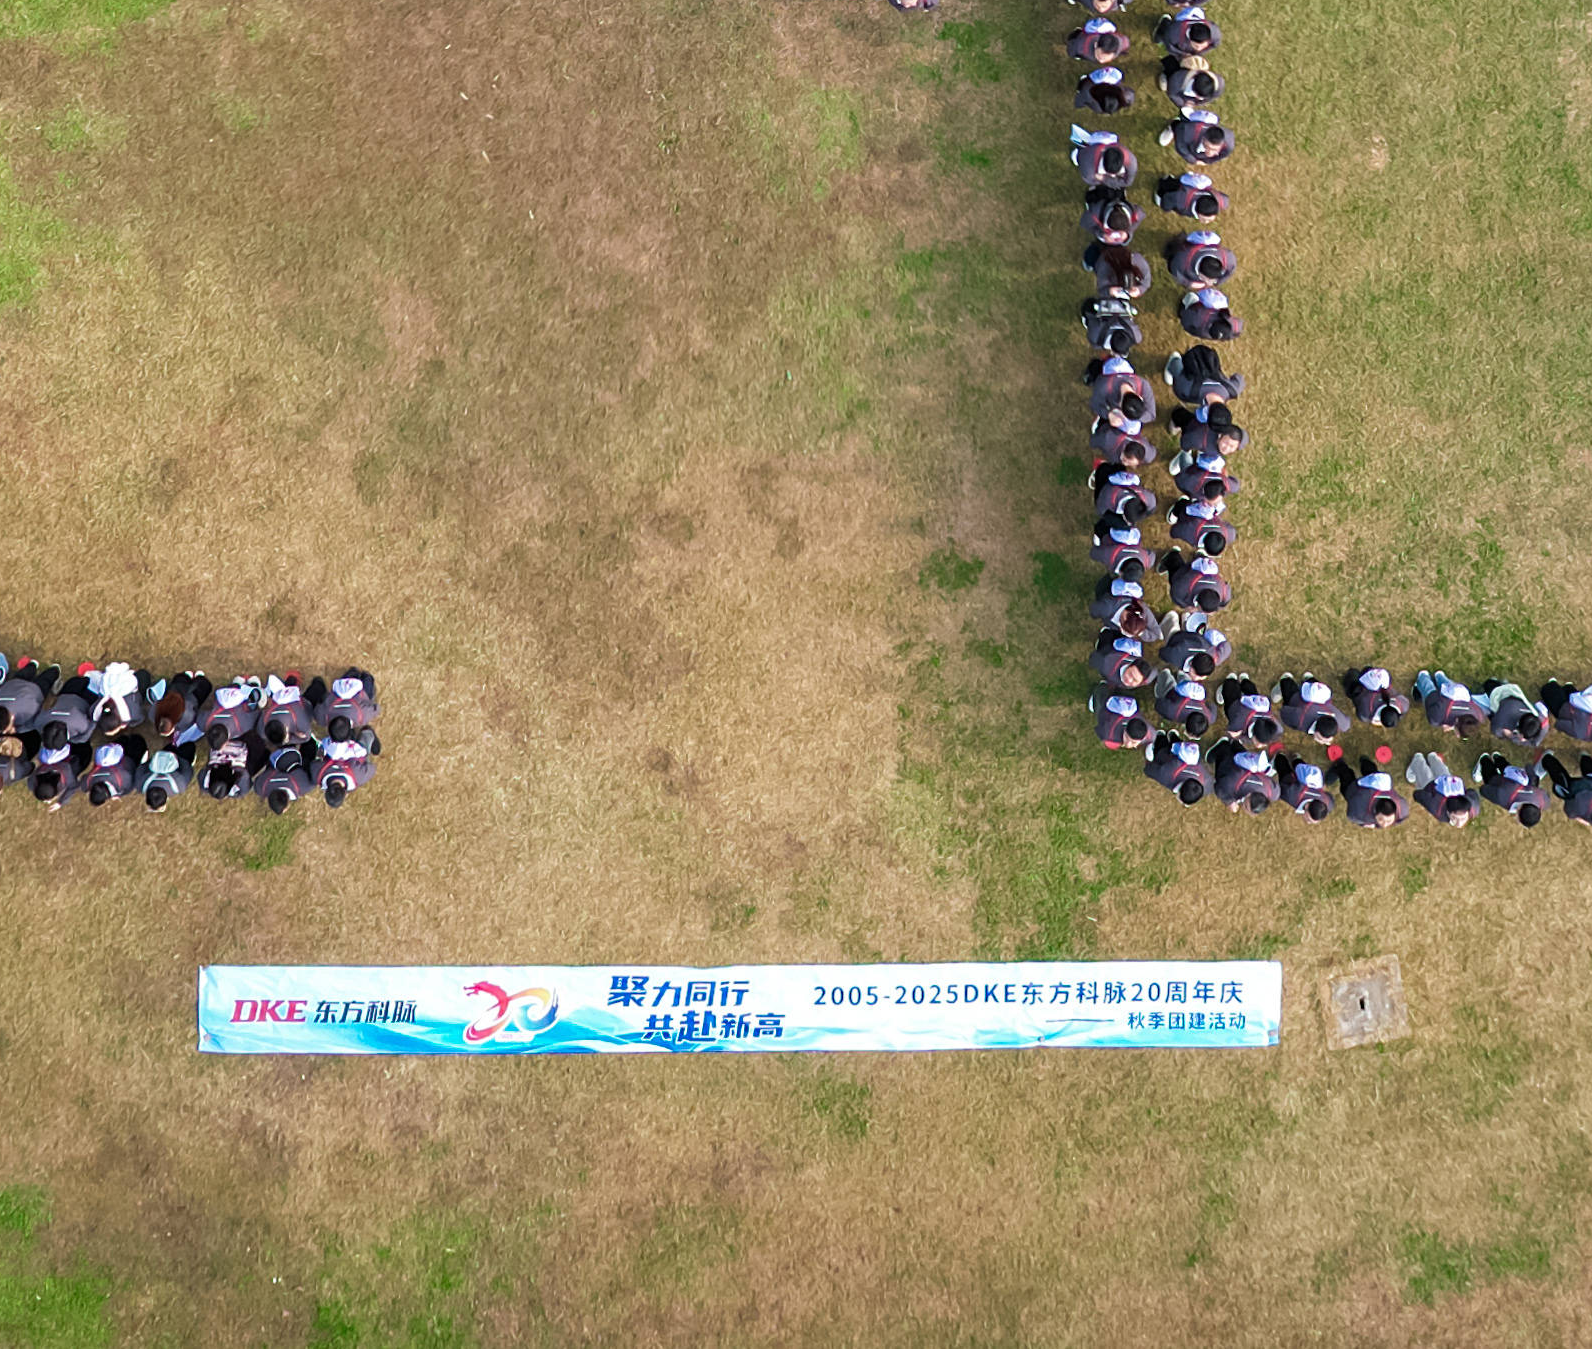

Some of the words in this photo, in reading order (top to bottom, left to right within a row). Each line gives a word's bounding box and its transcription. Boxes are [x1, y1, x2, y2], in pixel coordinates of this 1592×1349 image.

[608, 975, 750, 1008] 聚力同行
[230, 1000, 307, 1023] DKE
[313, 1000, 417, 1024] 东方科脉
[1127, 1011, 1247, 1031] 秋季团建活动
[643, 1010, 786, 1043] 共赴新高
